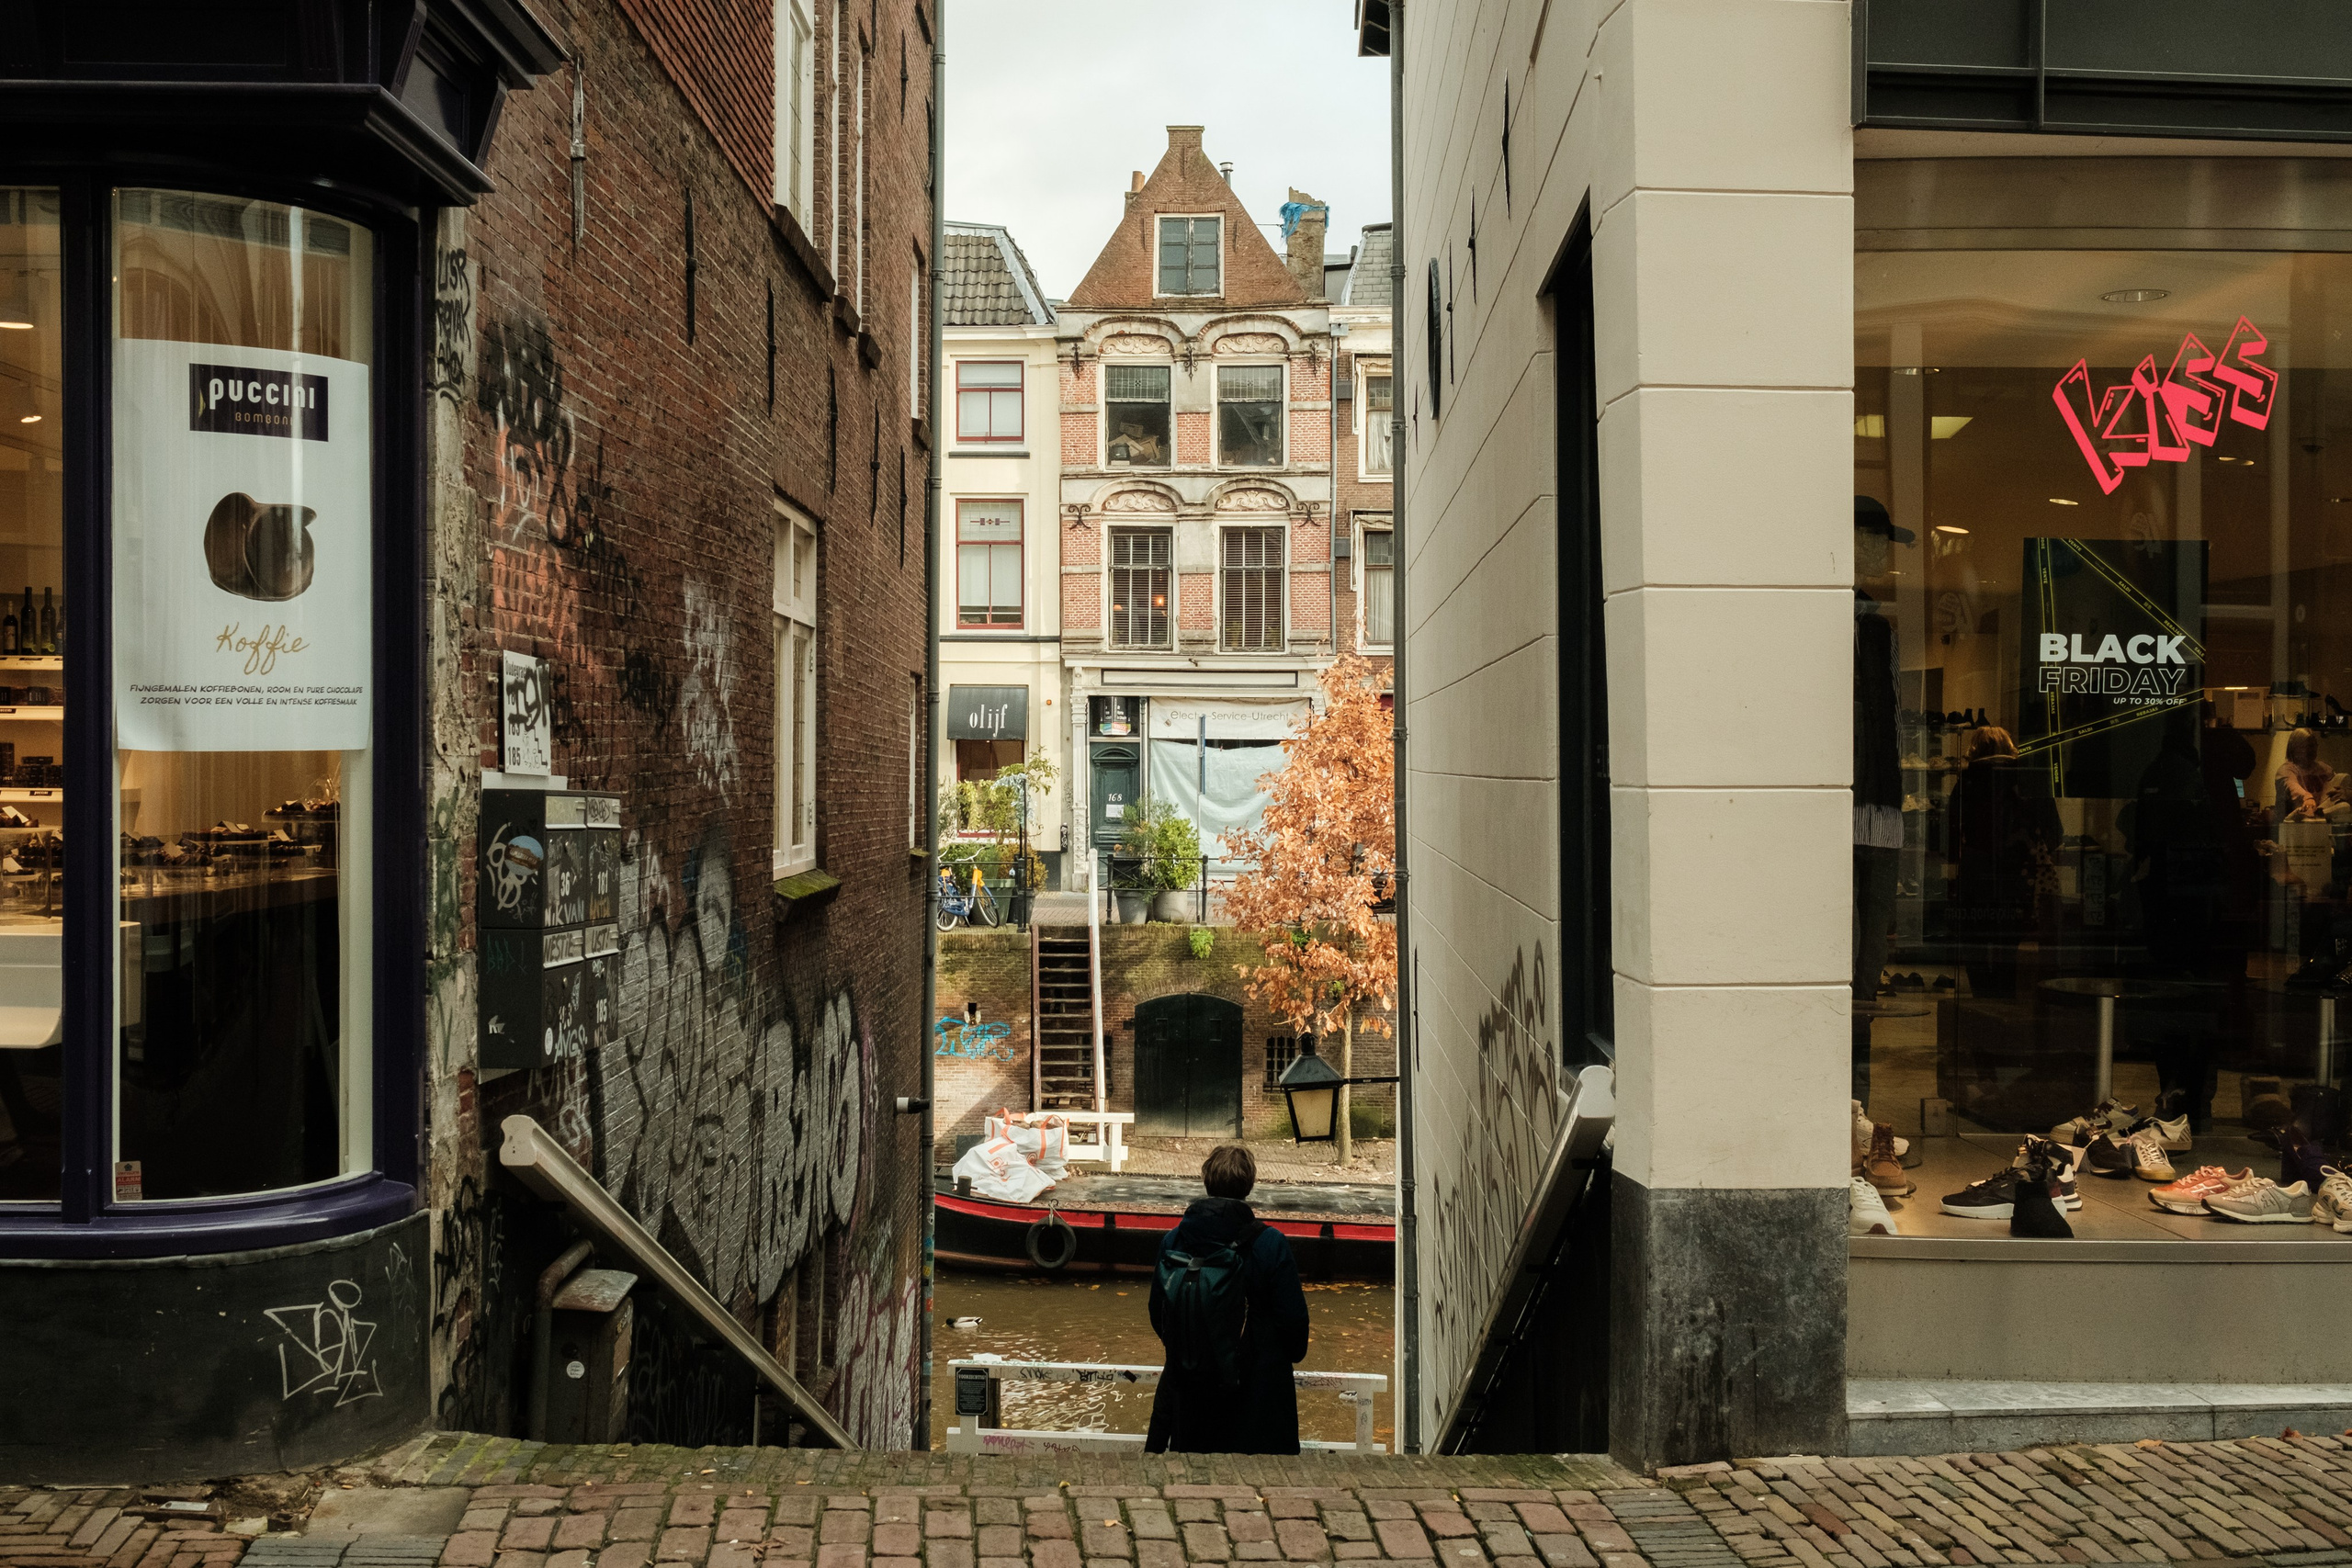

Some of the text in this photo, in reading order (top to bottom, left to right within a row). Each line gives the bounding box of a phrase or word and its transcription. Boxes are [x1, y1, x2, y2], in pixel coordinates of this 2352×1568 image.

[216, 622, 311, 675] Koffie
[2040, 633, 2187, 664] BLACK
[130, 684, 198, 694] FIJNGEMALEN
[266, 685, 291, 694] ROOM
[2038, 667, 2186, 695] FRIDAY
[140, 696, 181, 705] ZORGEN
[184, 697, 212, 705] VOOR
[214, 697, 233, 705] EEN
[236, 697, 264, 705] VOLLE
[2144, 697, 2164, 705] 30%
[969, 704, 1008, 738] olijf
[508, 746, 521, 766] 185
[1108, 793, 1123, 802] 168
[560, 871, 571, 897] 36
[597, 869, 608, 895] 181
[596, 998, 607, 1024] 185
